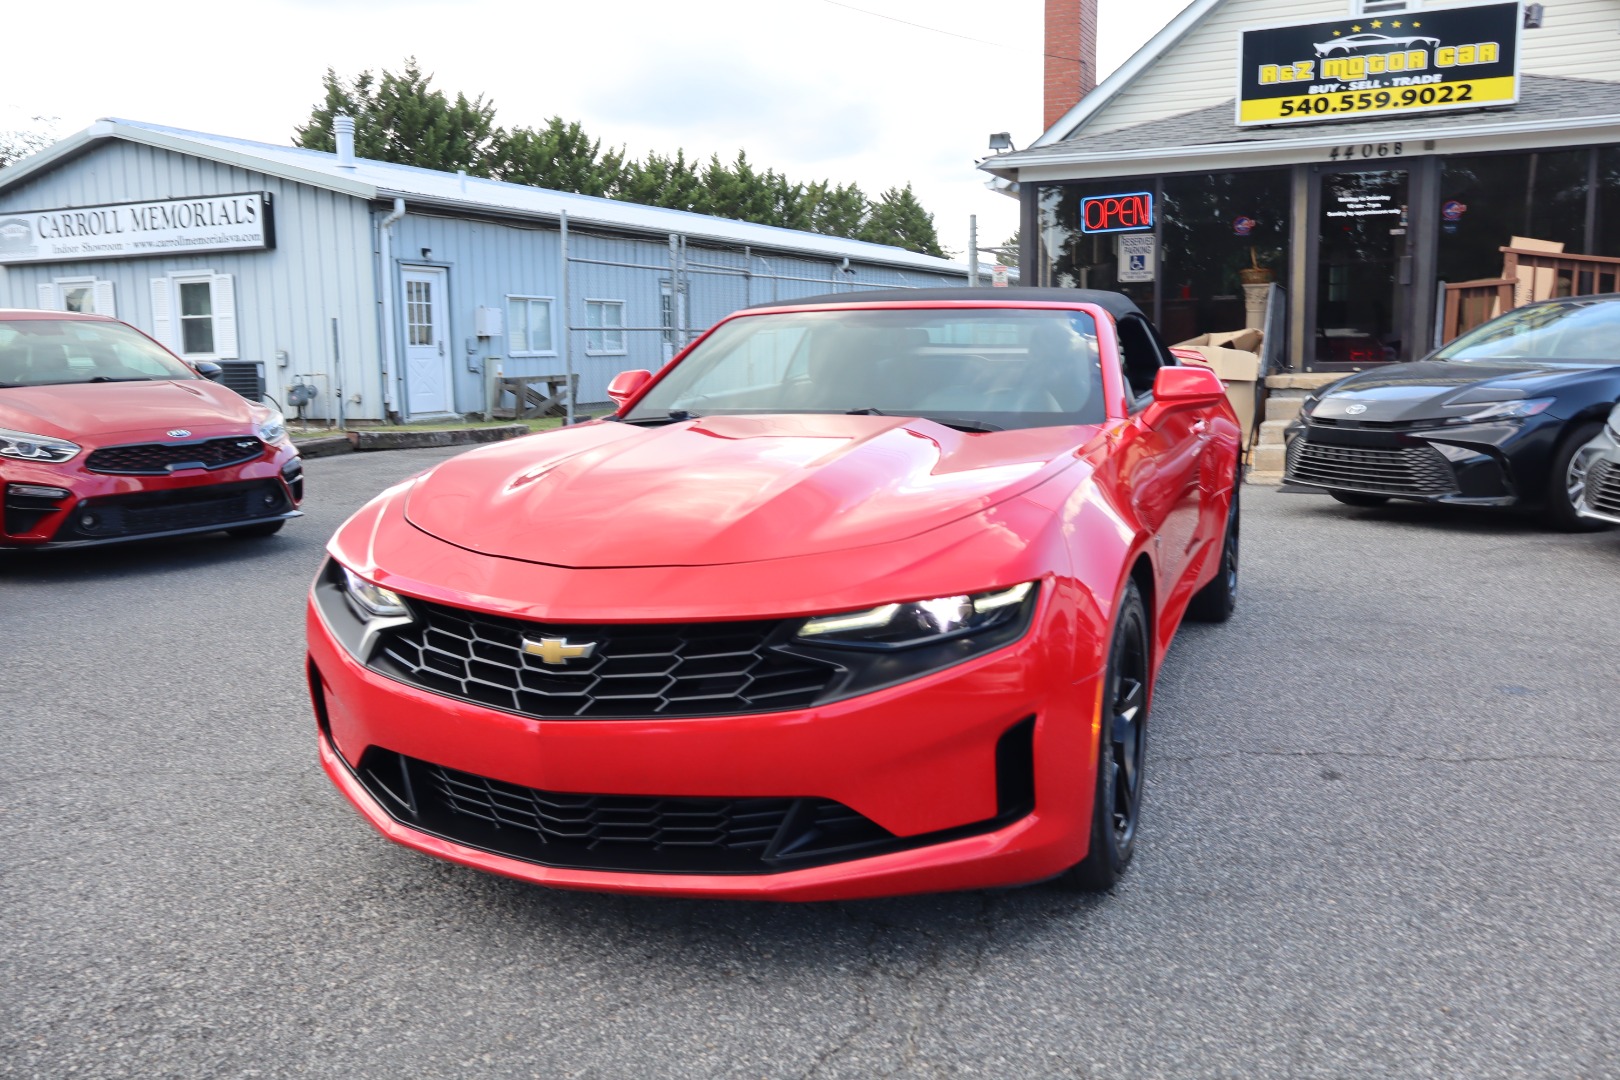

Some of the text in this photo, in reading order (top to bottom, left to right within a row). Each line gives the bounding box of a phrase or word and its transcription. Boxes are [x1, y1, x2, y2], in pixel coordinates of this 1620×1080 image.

[1320, 49, 1428, 82] MOTOR
[1280, 83, 1473, 117] 540.559.9022
[1308, 73, 1443, 95] BUY SELL TRADE
[1328, 142, 1403, 161] 44068
[37, 198, 257, 239] CARROLL MEMORIALS
[1084, 195, 1150, 230] OPEN
[52, 243, 79, 254] Indoor
[81, 242, 123, 253] Showroom
